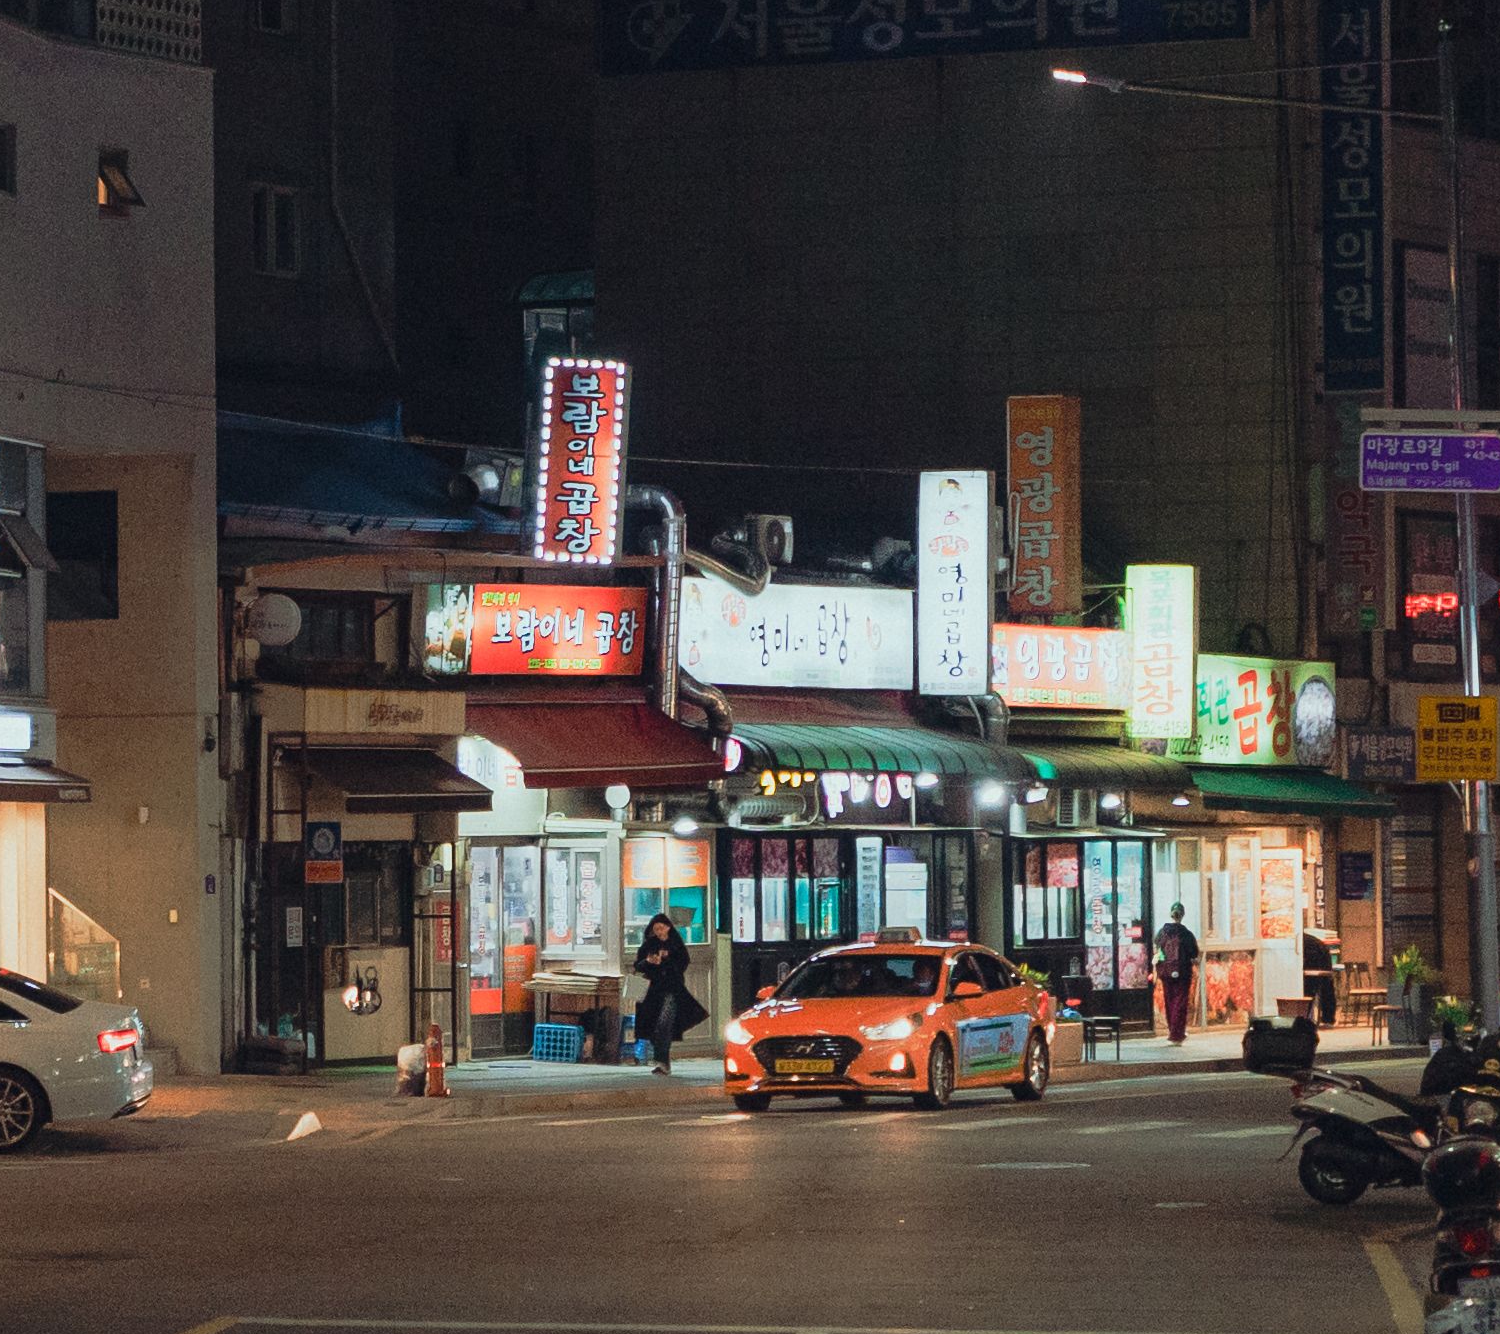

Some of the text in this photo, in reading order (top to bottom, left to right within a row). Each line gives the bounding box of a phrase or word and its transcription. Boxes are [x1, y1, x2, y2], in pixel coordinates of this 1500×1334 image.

[1162, 0, 1239, 28] 7585
[554, 371, 608, 556] 보람이네 곱창
[1367, 438, 1444, 456] 마장로9길
[1013, 426, 1062, 609] 영광곱창
[1337, 491, 1376, 575] 약국
[490, 607, 639, 656] 보람이네 곱창
[1016, 632, 1121, 682] 영광곱창
[1136, 642, 1184, 717] 곱창
[1232, 668, 1298, 757] 곱창
